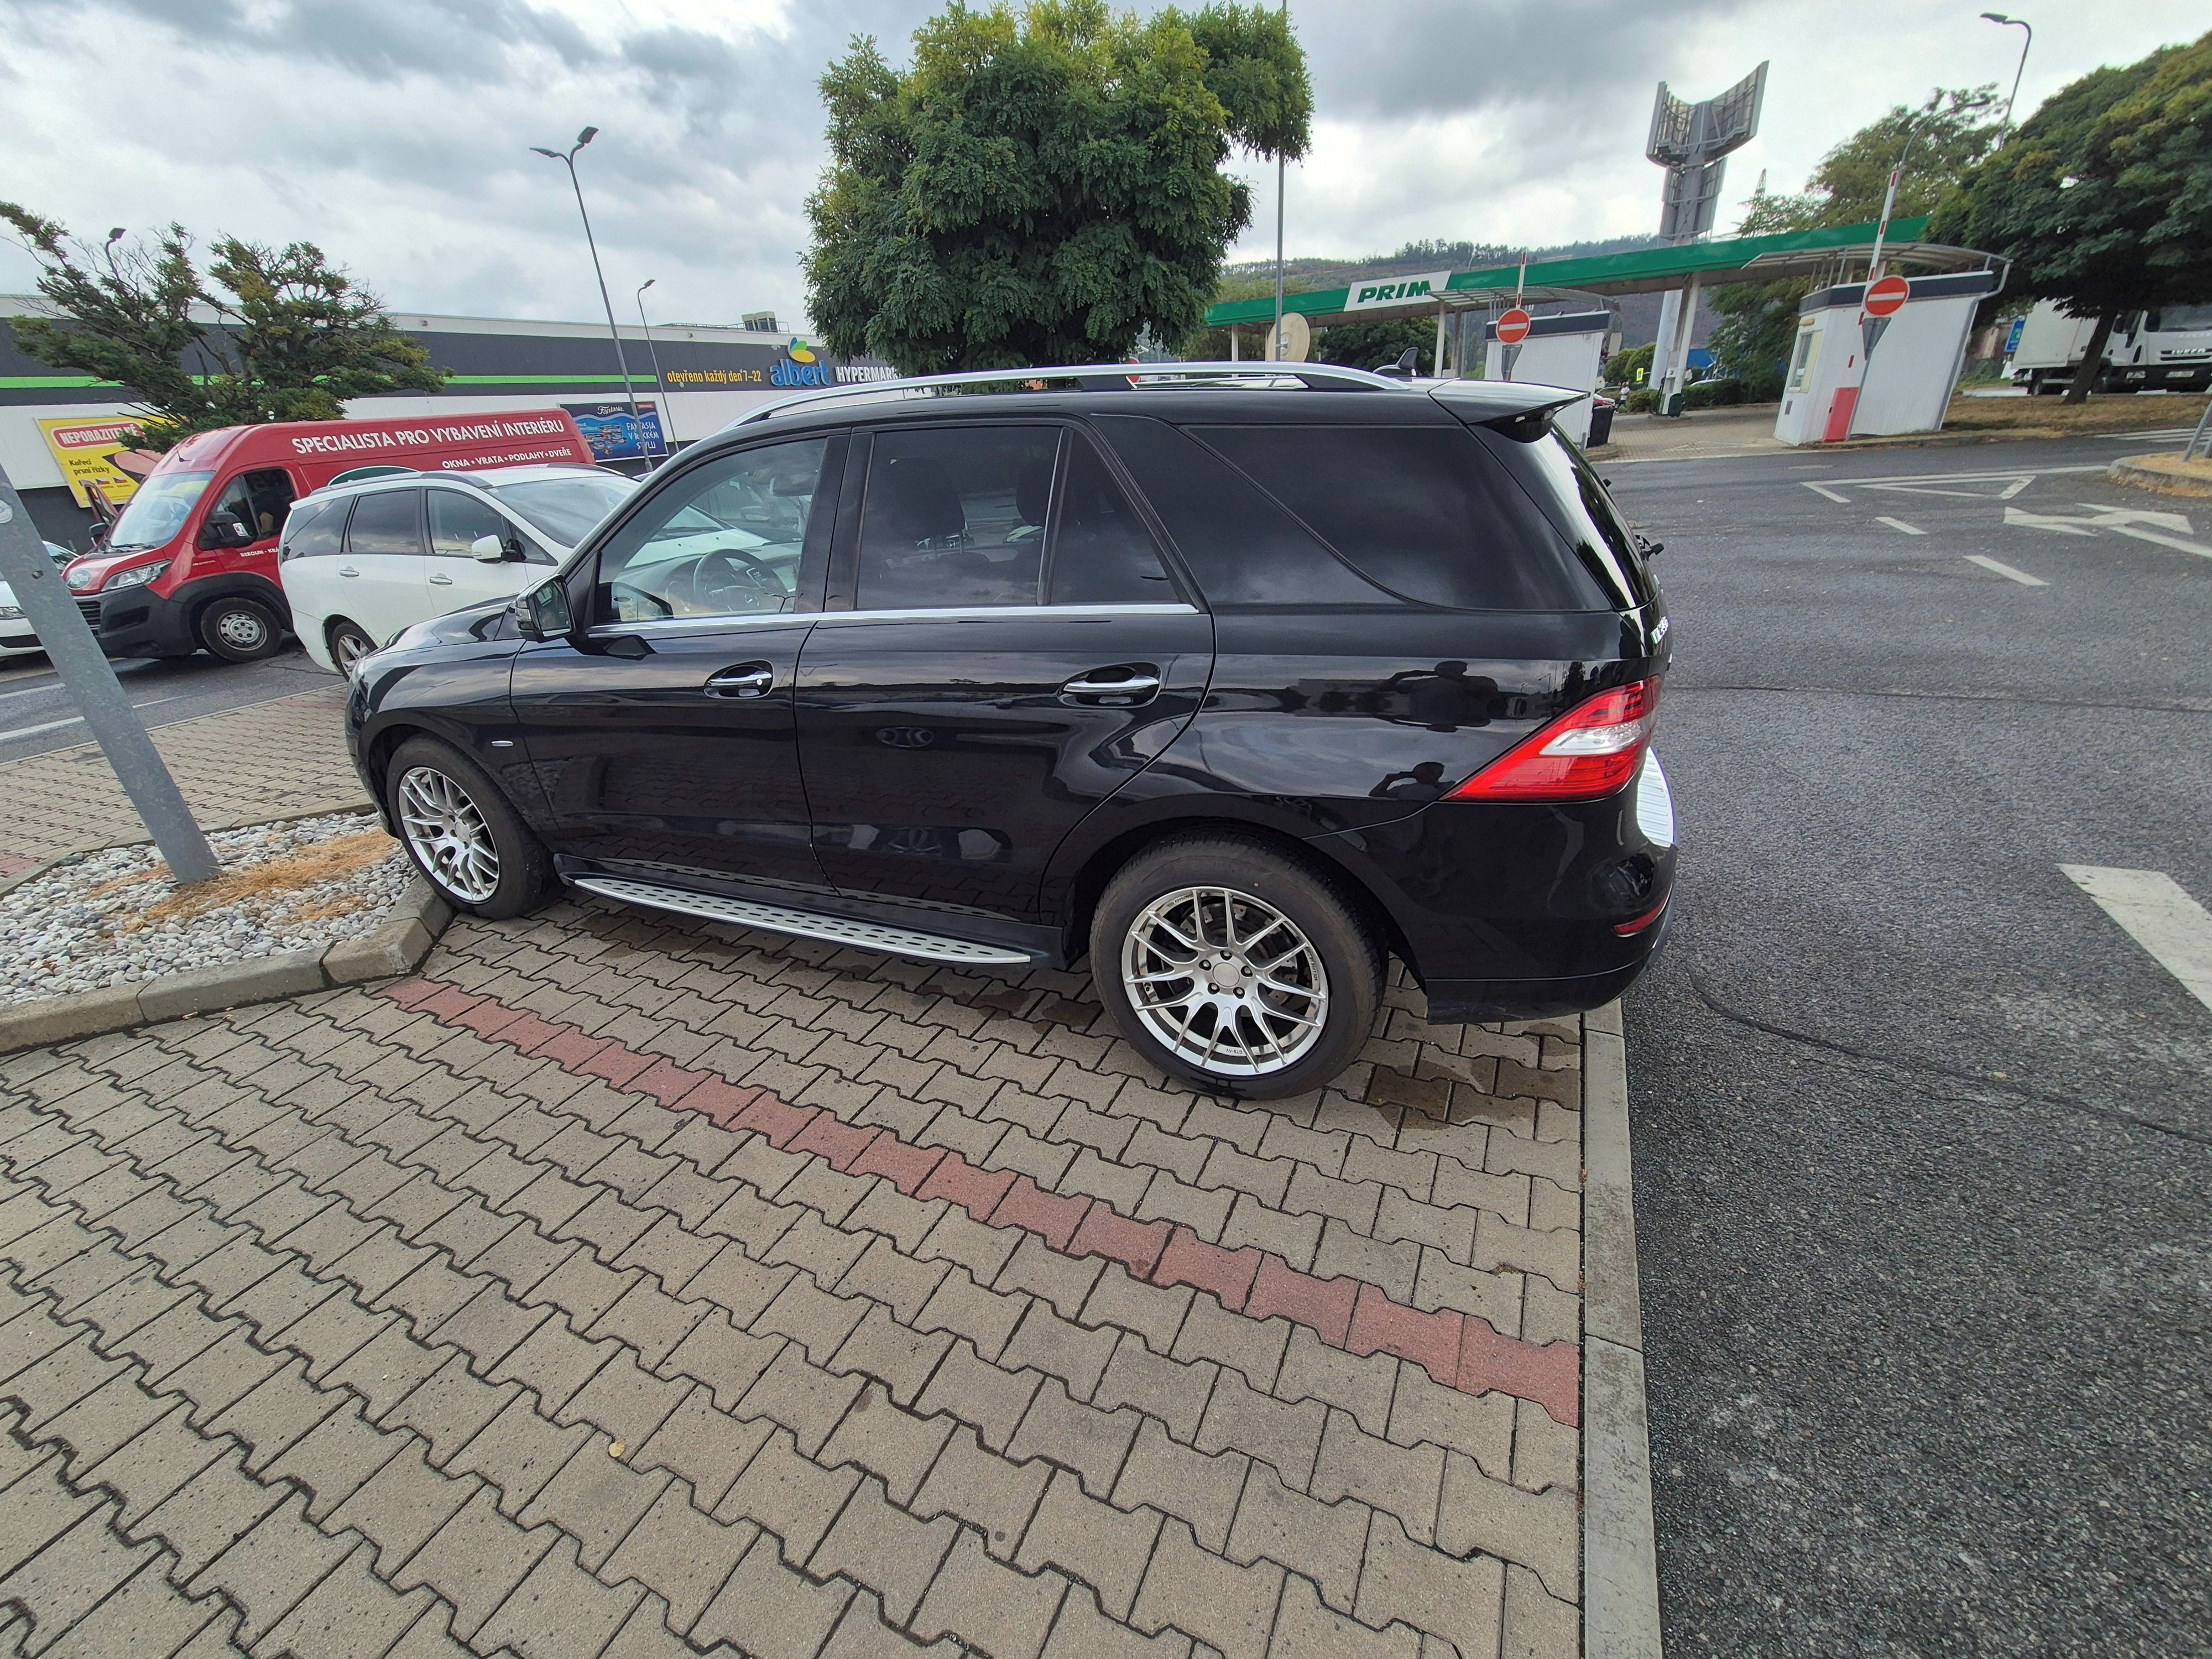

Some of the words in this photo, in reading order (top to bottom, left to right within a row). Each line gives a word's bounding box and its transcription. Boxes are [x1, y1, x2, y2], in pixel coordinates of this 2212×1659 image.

[1358, 280, 1431, 303] PRIM
[667, 369, 703, 382] otevřeno
[704, 370, 727, 384] každý
[728, 371, 743, 382] den
[769, 359, 831, 386] albert
[835, 366, 901, 383] HYPERMARK
[597, 405, 624, 415] Fantasia
[59, 424, 139, 445] NEPORAZITENÉ
[626, 421, 656, 430] FAASIA
[292, 432, 397, 454] SPECIALISTA
[394, 429, 430, 446] PRO
[429, 420, 503, 442] VYBAVENÍ
[502, 417, 564, 437] INTERIÉRU
[442, 458, 471, 469] OKNA
[474, 456, 505, 465] VRATA
[508, 451, 545, 462] PODLAHY
[547, 447, 572, 457] DVEŘE
[73, 467, 91, 476] prsní
[91, 466, 109, 474] řízky
